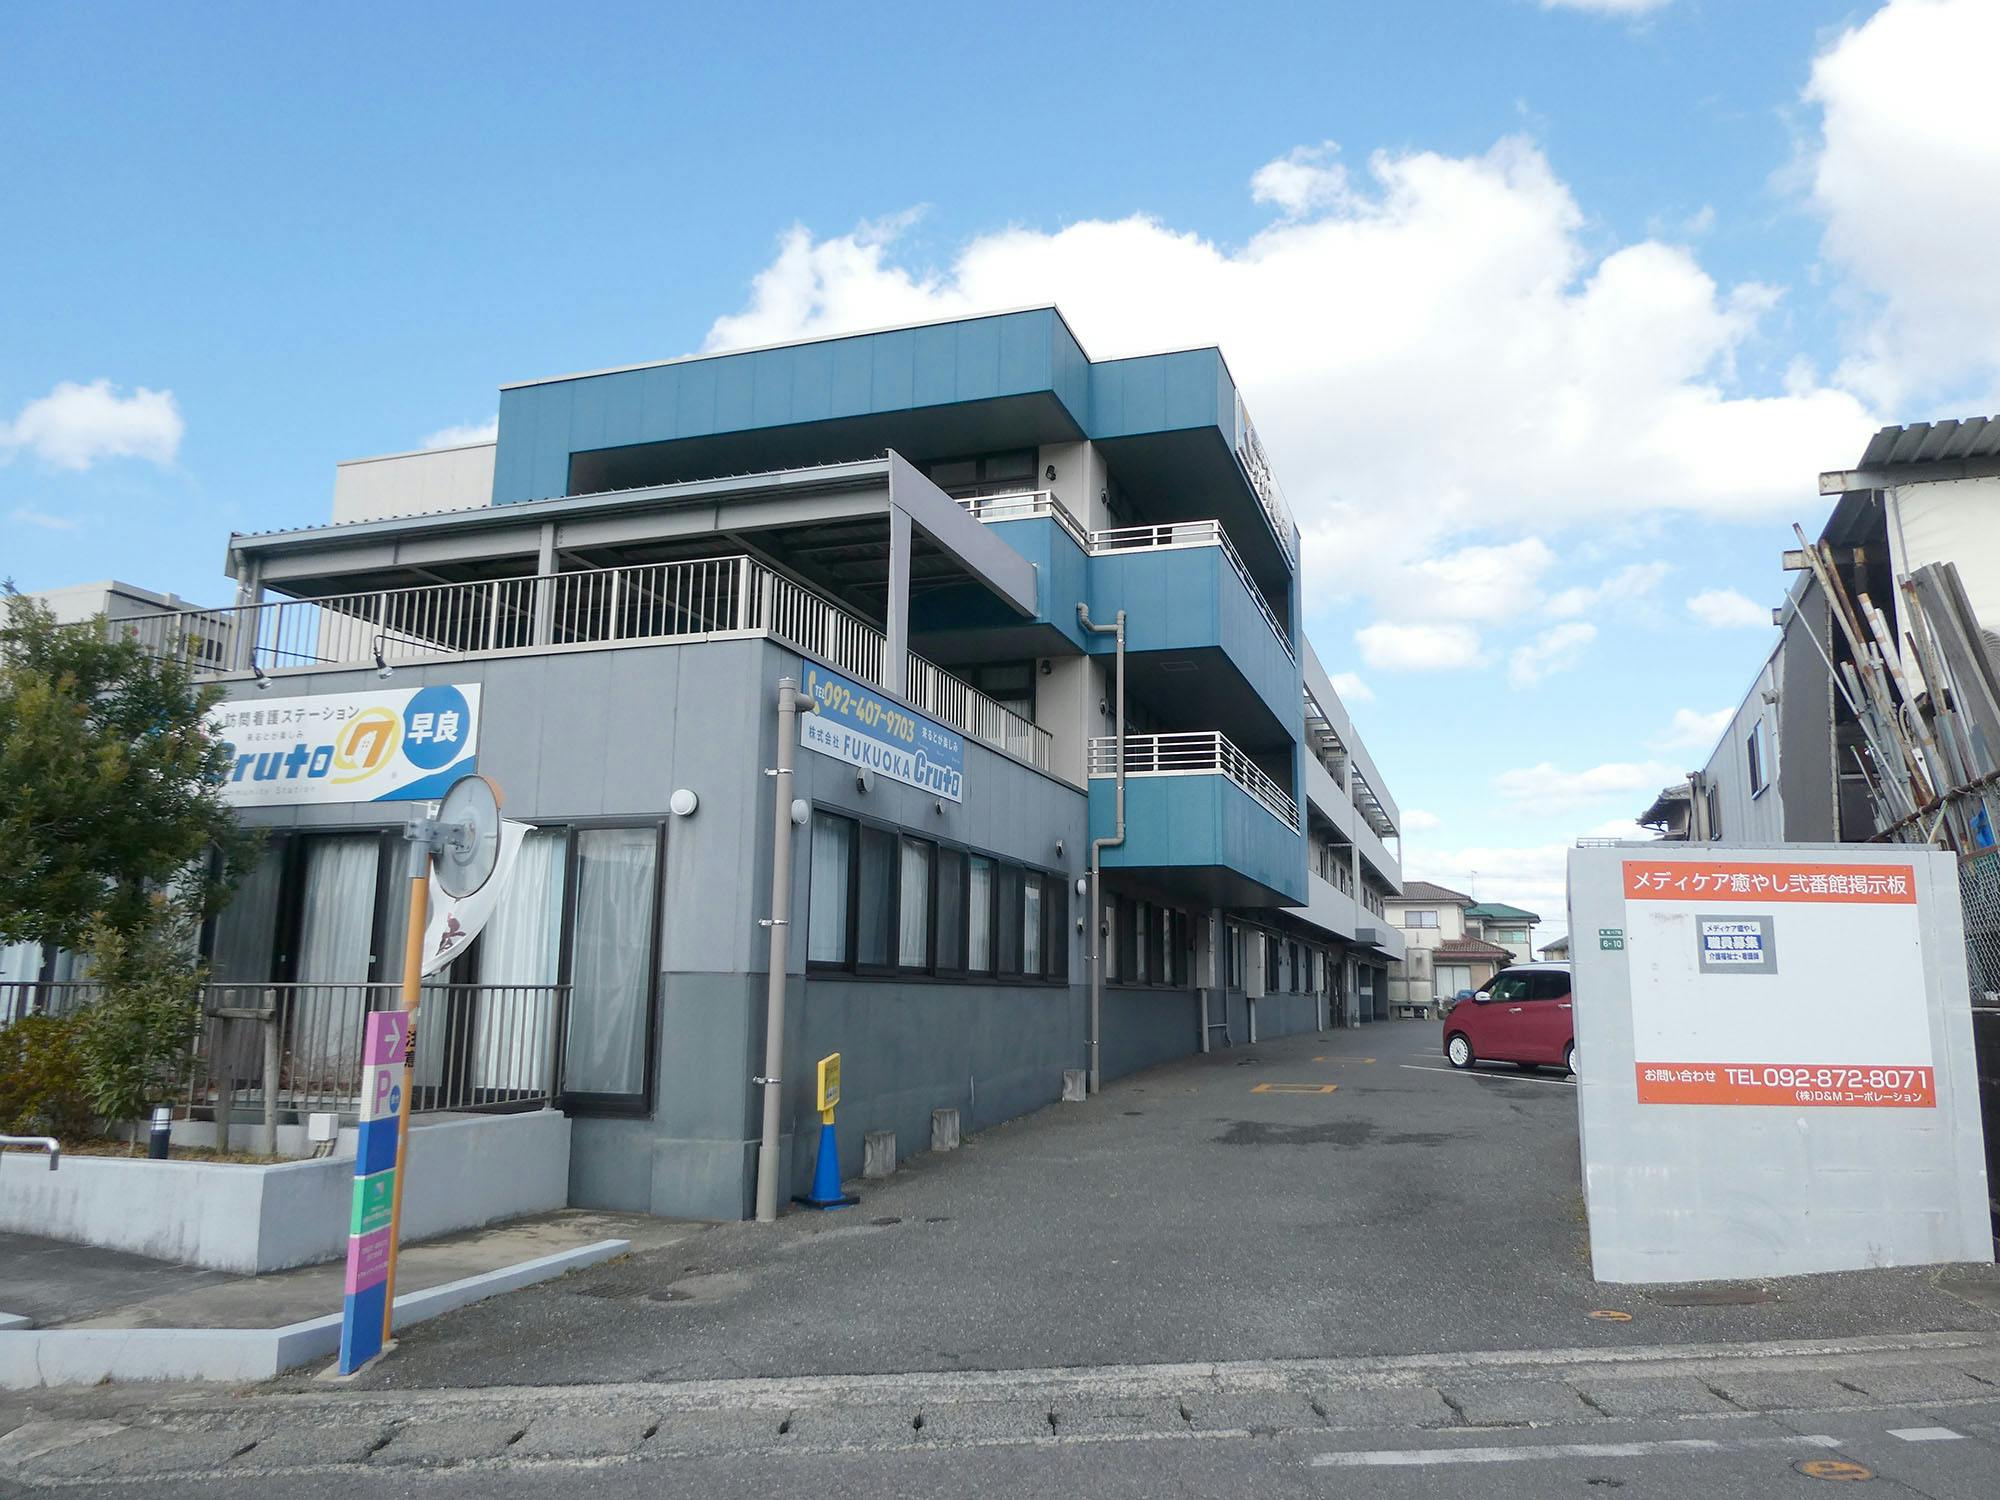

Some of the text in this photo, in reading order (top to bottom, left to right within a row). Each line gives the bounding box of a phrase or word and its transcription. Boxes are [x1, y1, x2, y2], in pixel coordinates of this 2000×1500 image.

[224, 705, 360, 728] 訪問看護ステーション
[815, 681, 916, 743] TEL 092-407-9703
[408, 711, 460, 745] 早良
[808, 725, 840, 749] 株式会社
[843, 734, 911, 779] FUKUOKA
[913, 750, 960, 798] Cruto
[1633, 871, 1908, 896] メディケア癒やし弐番館掲示板
[1603, 939, 1622, 948] 6-10
[1644, 1069, 1717, 1083] お問い合わせ
[374, 1069, 392, 1115] P
[1845, 1091, 1923, 1103] コーポレーション
